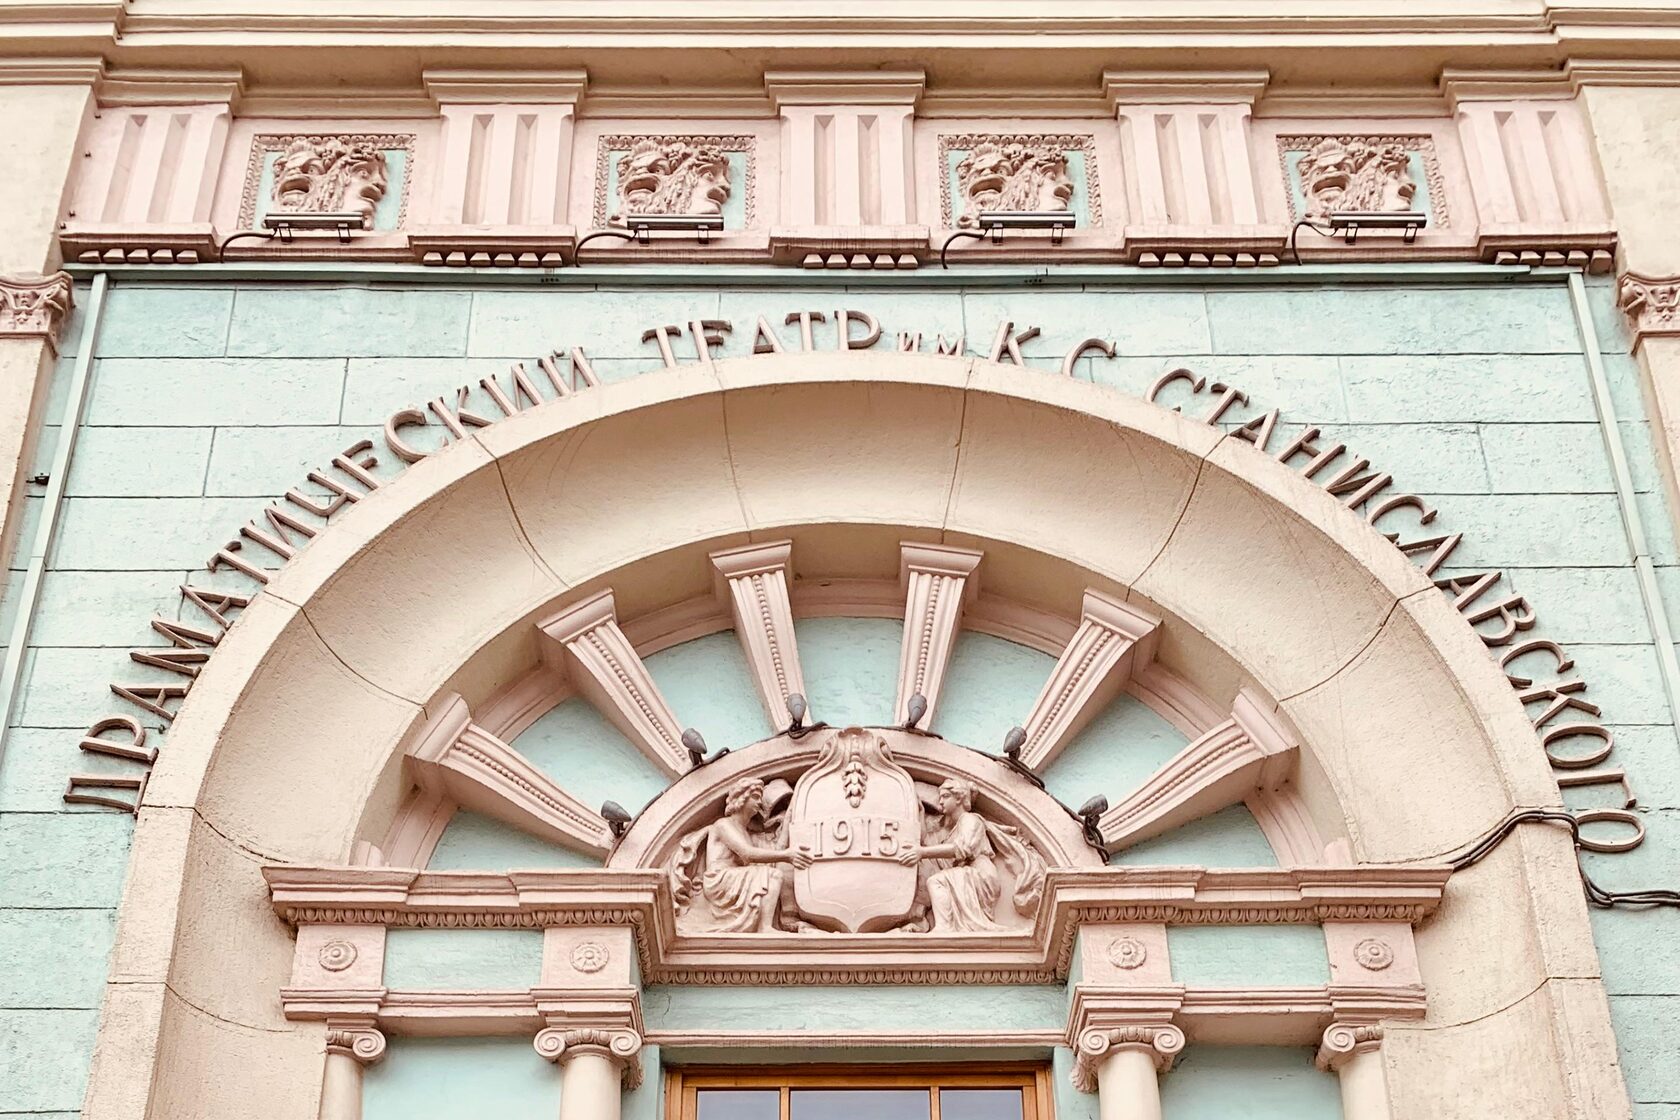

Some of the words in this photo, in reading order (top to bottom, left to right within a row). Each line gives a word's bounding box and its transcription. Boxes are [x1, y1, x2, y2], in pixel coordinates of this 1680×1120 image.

[64, 346, 603, 814] ДРАМАТИЧЕСКИЙ
[641, 310, 883, 368] ТЕАТР
[988, 321, 1041, 366] К
[1062, 337, 1117, 376] С
[1144, 368, 1647, 853] СТАНИСЛАВСКОГО
[813, 820, 900, 857] 1915
